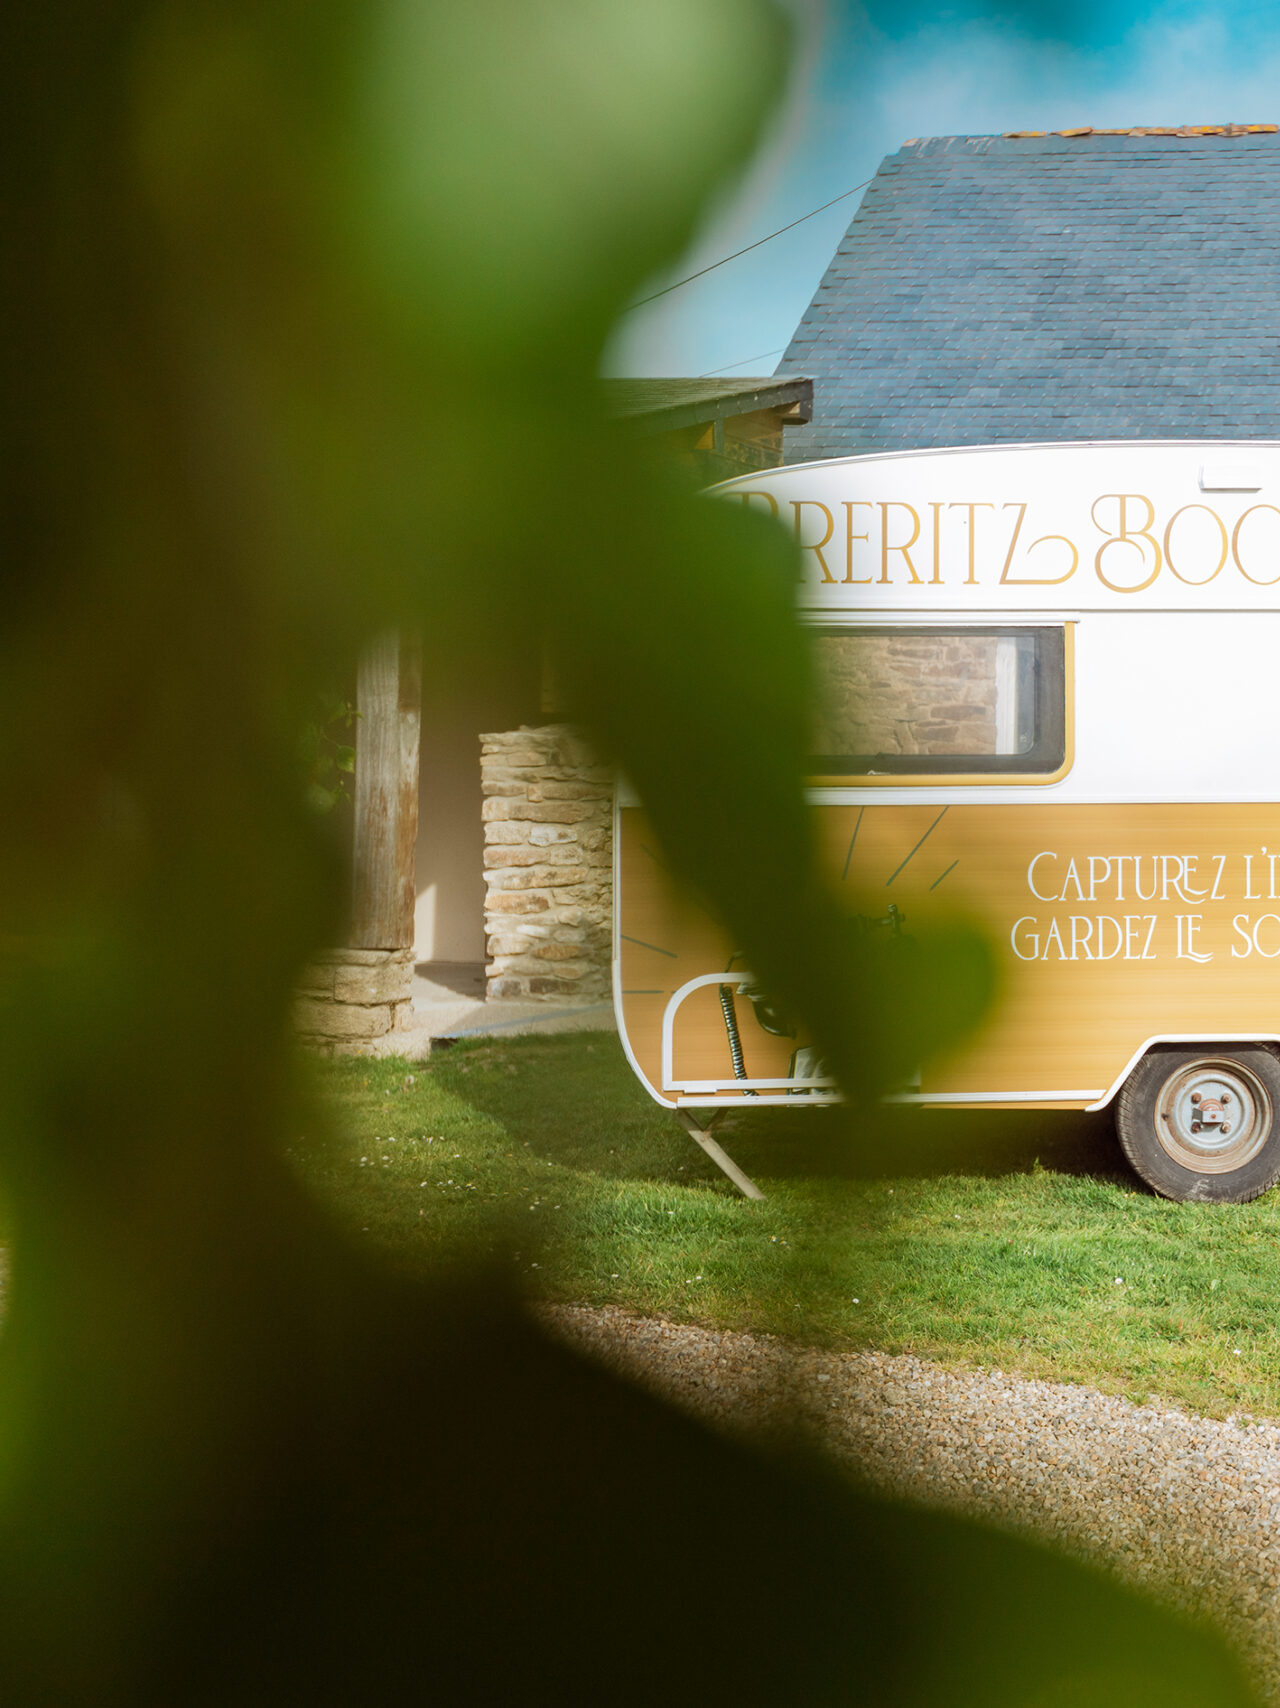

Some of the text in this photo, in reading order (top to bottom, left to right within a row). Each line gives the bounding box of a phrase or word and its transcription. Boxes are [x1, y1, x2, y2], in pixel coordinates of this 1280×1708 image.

[1027, 851, 1227, 905] CAPTUREZ
[1010, 915, 1158, 961] GARDEZ
[1174, 914, 1214, 964] LE
